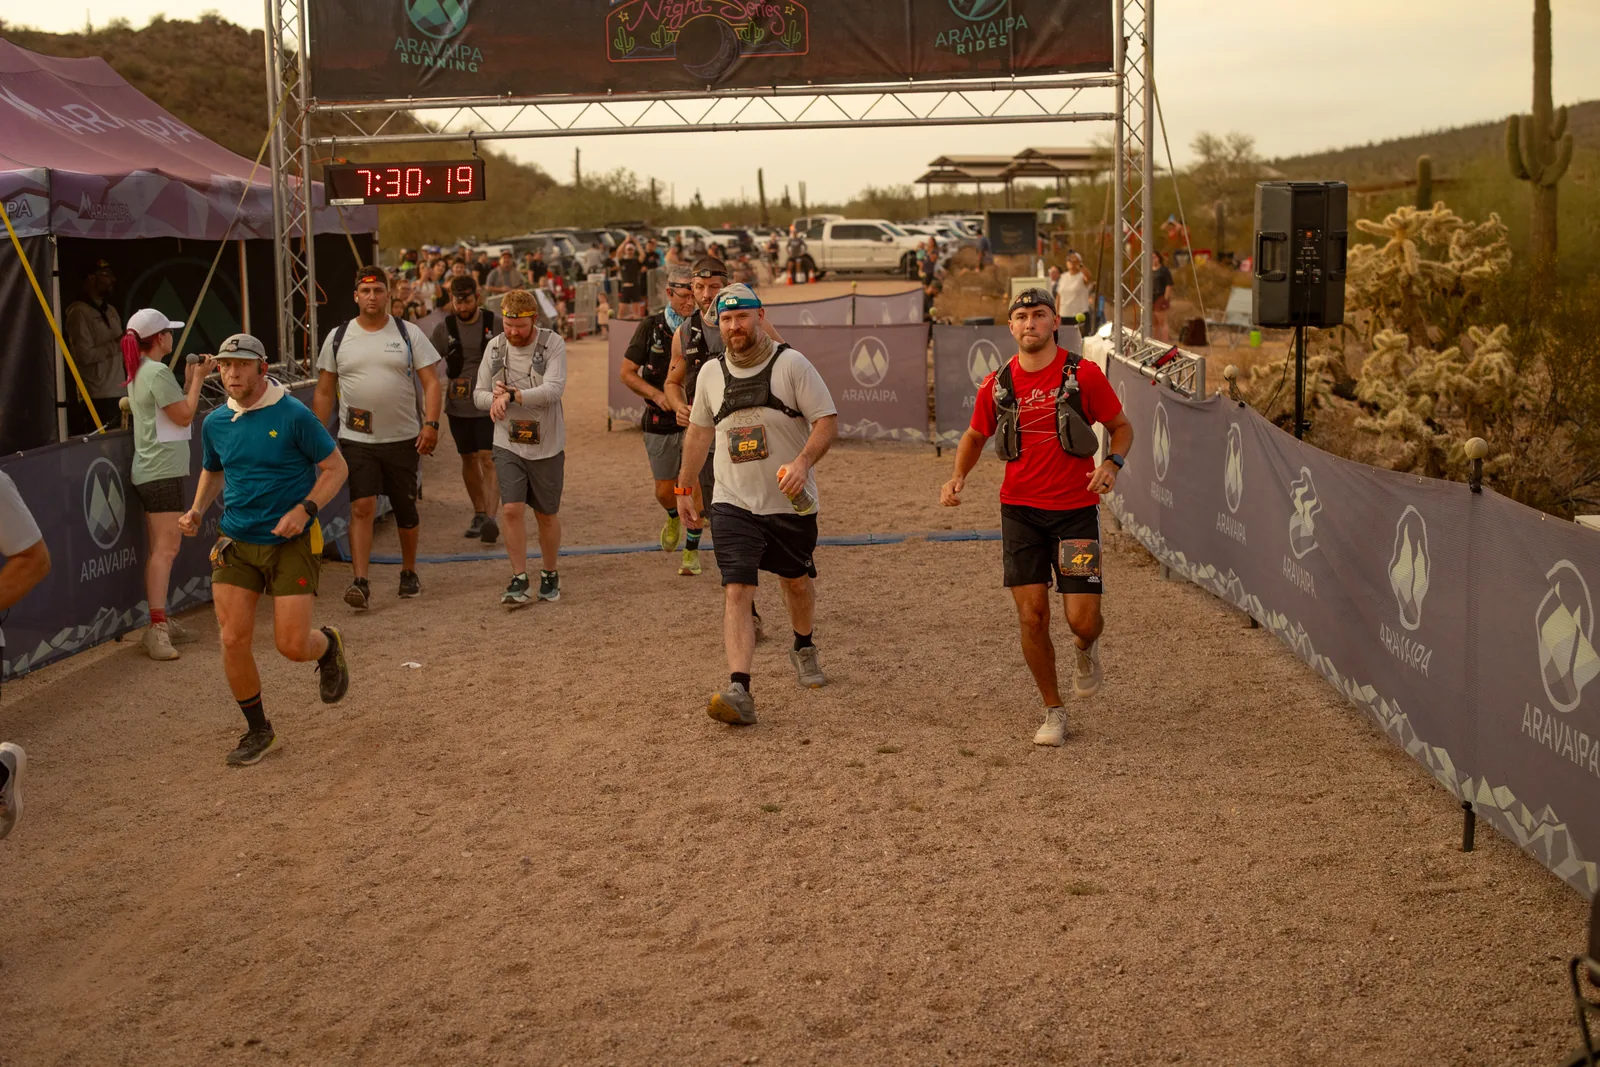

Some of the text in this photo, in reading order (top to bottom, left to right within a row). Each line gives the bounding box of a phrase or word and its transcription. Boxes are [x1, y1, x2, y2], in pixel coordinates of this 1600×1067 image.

[935, 15, 1028, 47] ARAVAIPA
[394, 36, 484, 62] ARAVAIPA
[956, 35, 1008, 55] RIDES
[400, 53, 478, 73] RUNNING
[842, 389, 898, 402] ARAVAIPA
[353, 417, 365, 427] 74
[518, 430, 532, 438] 73
[738, 439, 758, 452] 69
[1216, 512, 1247, 546] ARAVAIPA
[80, 546, 137, 583] ARAVAIPA
[1071, 554, 1094, 564] 47
[1282, 554, 1317, 599] ARAVAIPA
[1379, 622, 1432, 678] ARAVAIPA
[1521, 702, 1600, 778] ARAVAIPA
